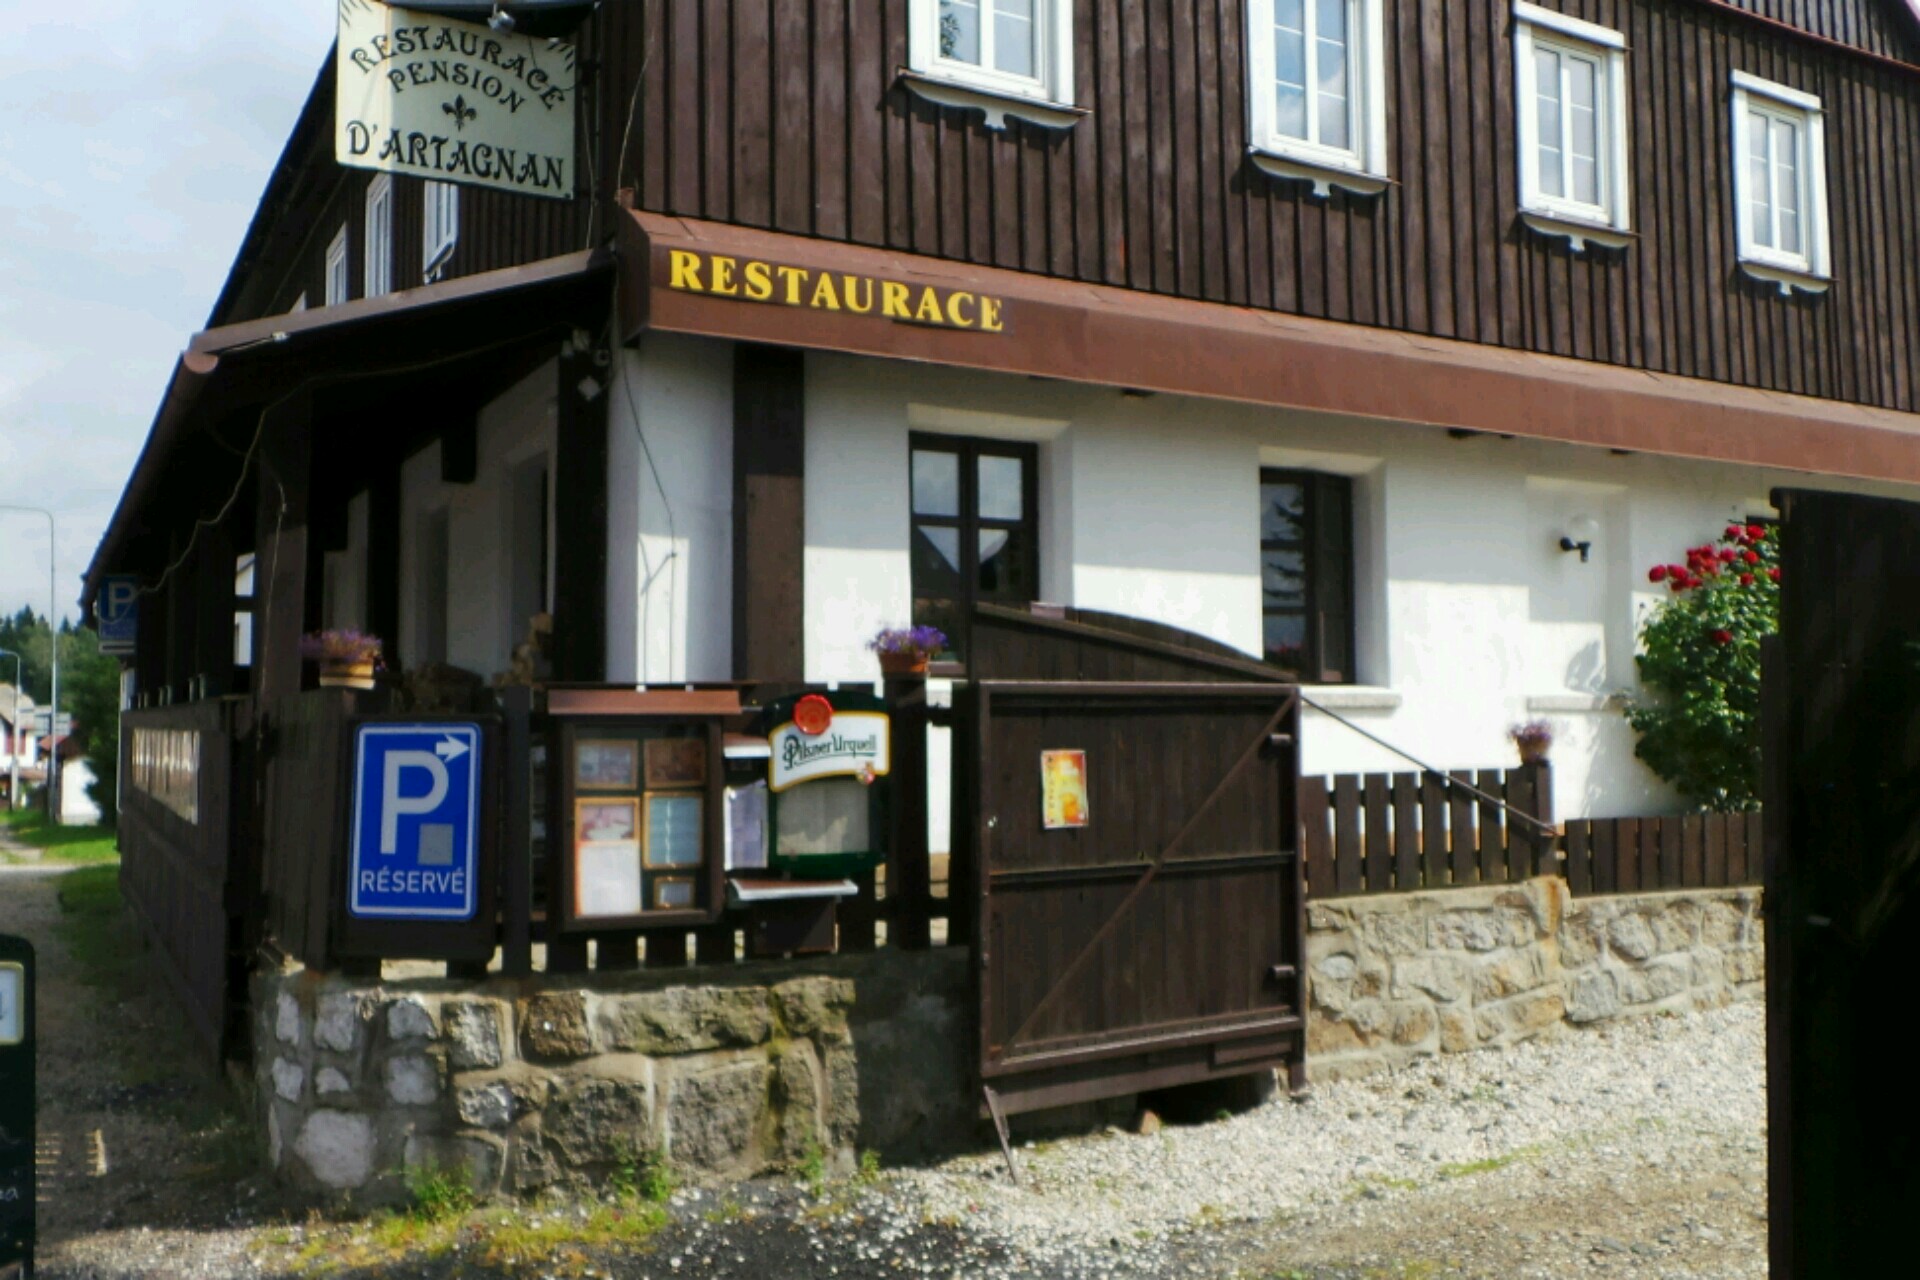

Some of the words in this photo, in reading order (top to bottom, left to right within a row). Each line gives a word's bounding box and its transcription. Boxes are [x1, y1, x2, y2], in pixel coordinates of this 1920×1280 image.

[351, 25, 565, 110] RESTAURACE
[387, 60, 526, 114] PENSION
[346, 120, 564, 190] D'ARTAGNAN
[669, 249, 1004, 332] RESTAURACE
[108, 581, 138, 617] P
[782, 735, 832, 770] Pilsner
[831, 733, 877, 758] Urquell
[380, 749, 449, 855] P
[360, 865, 465, 894] RÉSERVÉ
